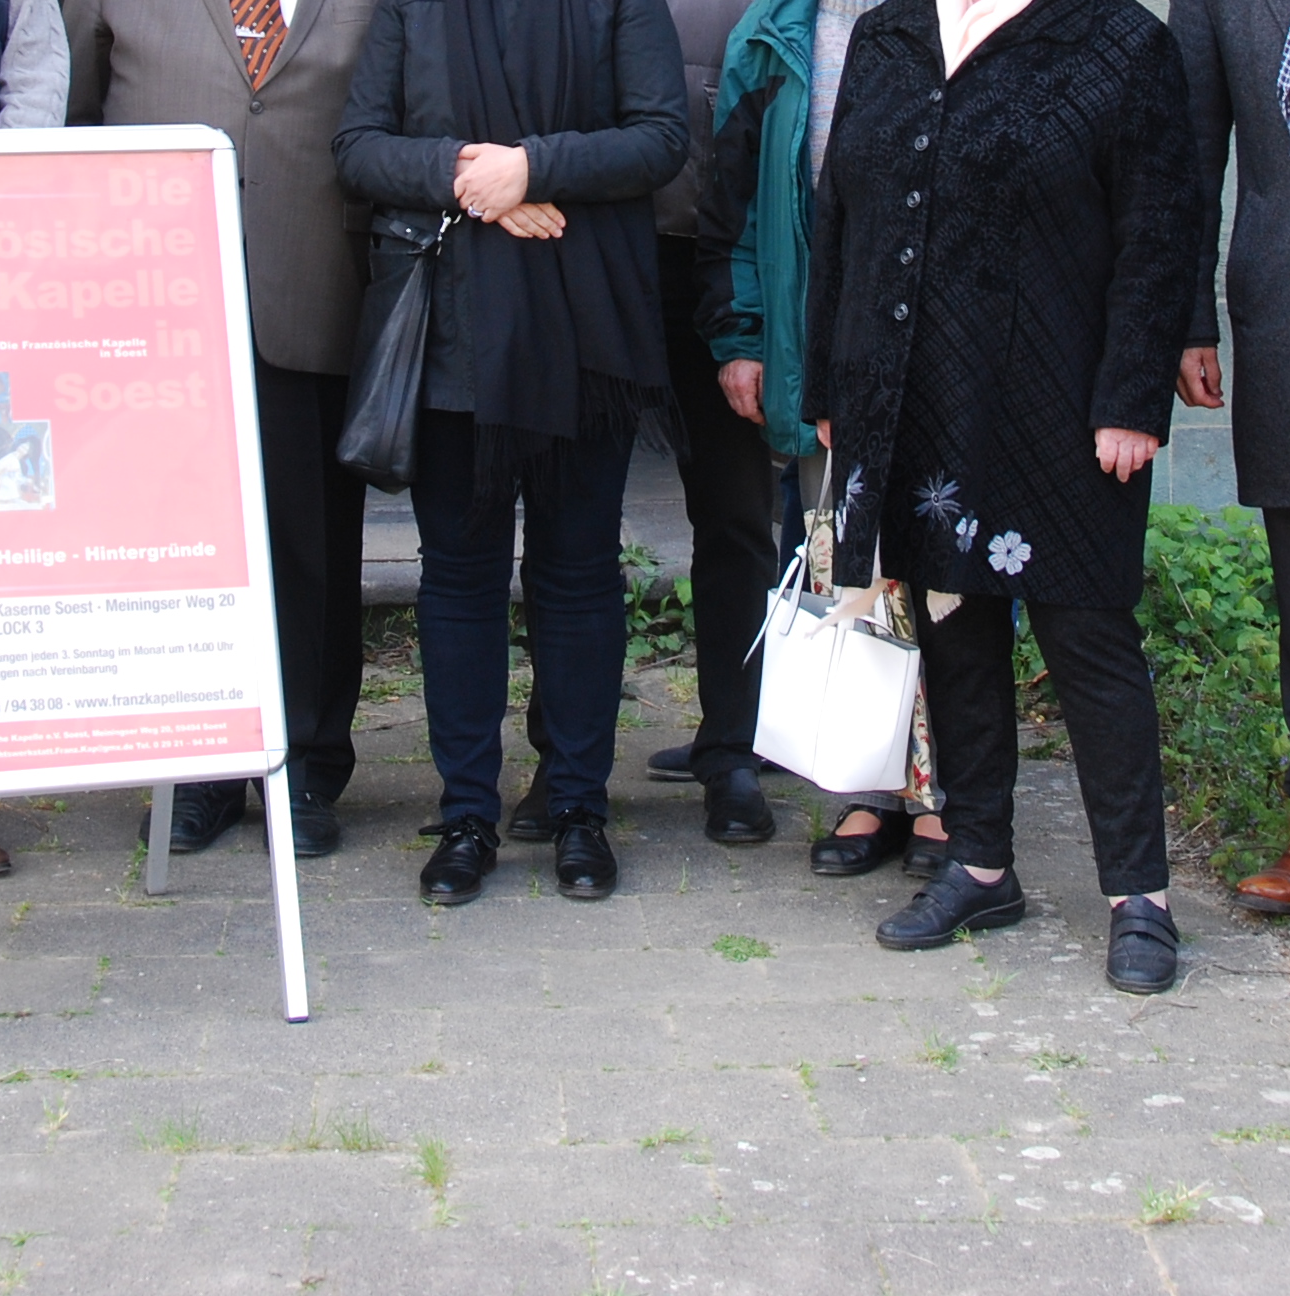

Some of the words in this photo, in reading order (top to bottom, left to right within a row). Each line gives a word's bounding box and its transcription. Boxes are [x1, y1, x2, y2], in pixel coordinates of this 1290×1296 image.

[107, 168, 192, 207] Die
[21, 339, 99, 349] Französische
[101, 337, 147, 351] Kapelle
[155, 320, 203, 358] in
[99, 349, 111, 358] in
[113, 347, 148, 358] Soest
[53, 371, 207, 412] Soest
[84, 540, 217, 563] Hintergründe
[54, 600, 93, 615] Soest
[105, 597, 181, 613] Meiningser
[185, 594, 215, 610] Weg
[218, 593, 235, 607] 20
[35, 620, 44, 634] 3
[30, 650, 59, 662] jeden
[62, 649, 70, 659] 3.
[72, 648, 115, 659] Sonntag
[117, 647, 131, 656] im
[133, 644, 165, 655] Monat
[168, 645, 184, 654] um
[187, 641, 214, 652] 14.00
[216, 641, 233, 651] Uhr
[22, 666, 47, 677] nach
[49, 664, 118, 675] Vereinbarung
[74, 687, 243, 708] www.franzkapellesoest.de
